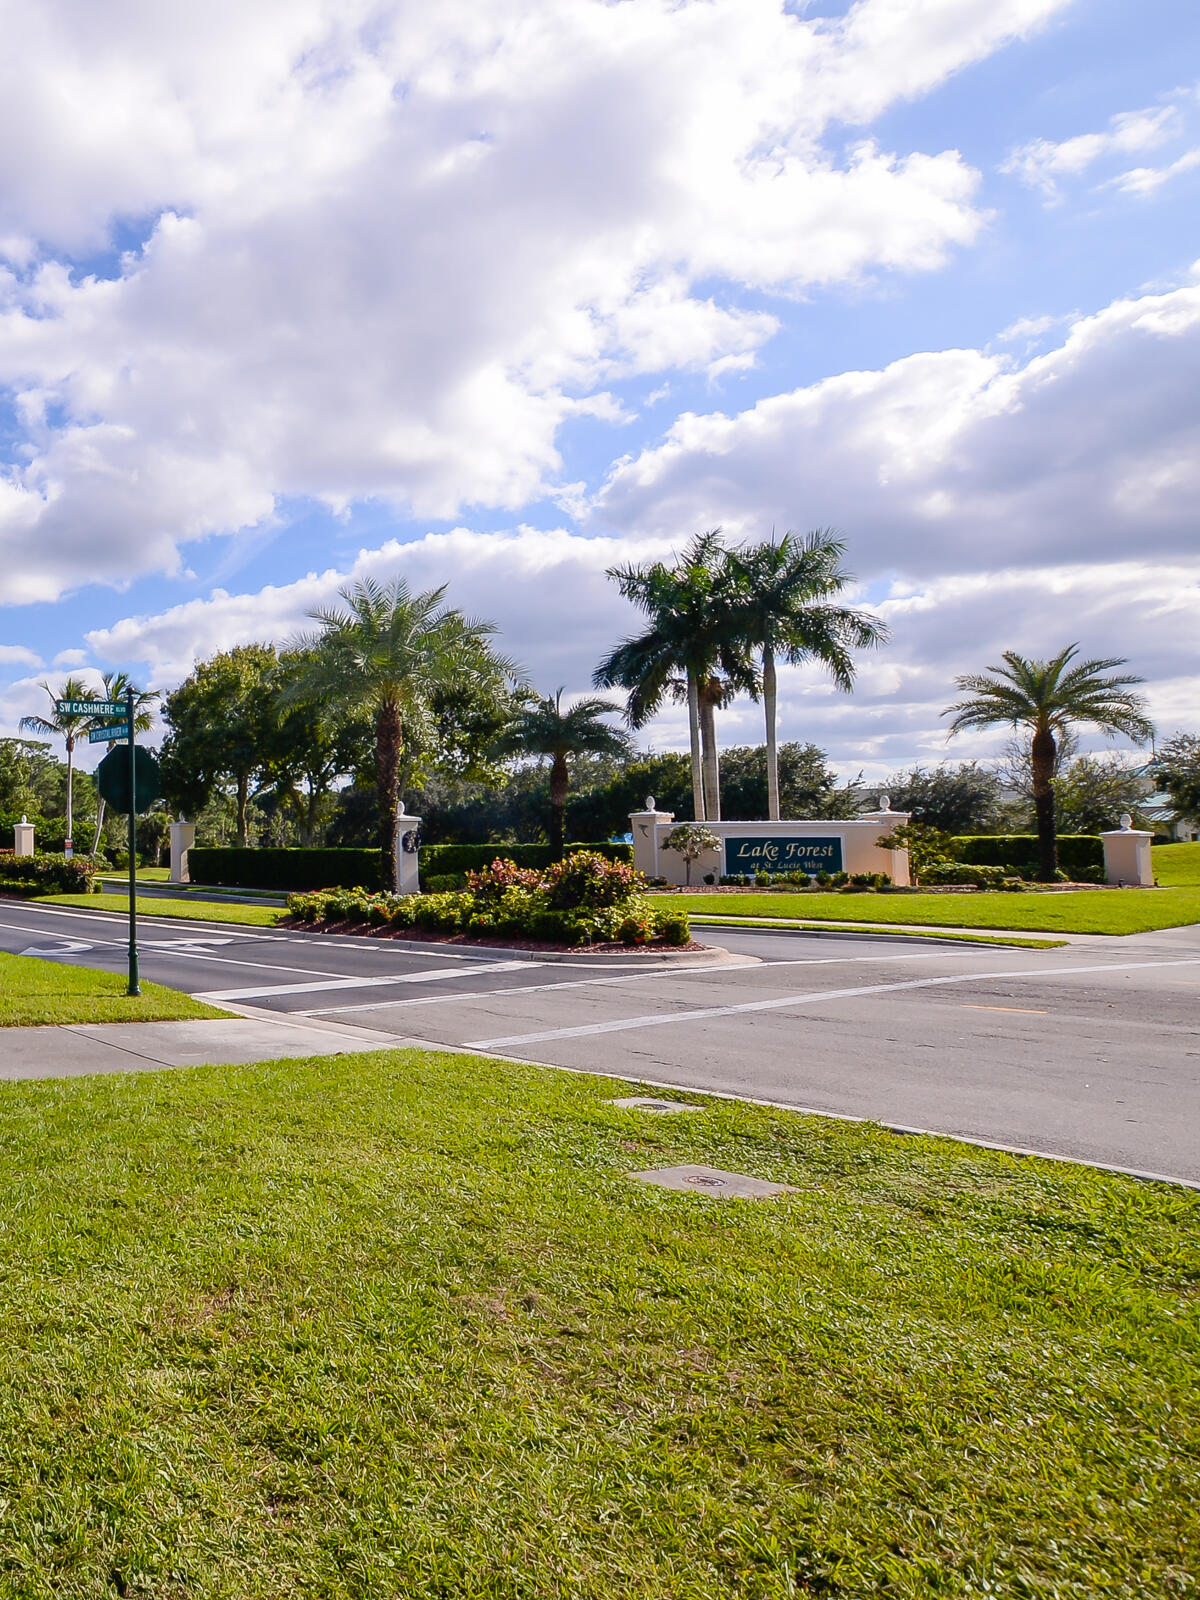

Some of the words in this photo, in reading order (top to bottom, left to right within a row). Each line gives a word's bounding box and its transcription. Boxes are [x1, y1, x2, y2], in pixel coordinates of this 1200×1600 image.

[59, 702, 71, 713] SW
[72, 702, 115, 714] CASHMERE
[96, 729, 111, 740] CRYSTAL
[111, 727, 122, 737] RIVER
[736, 840, 779, 861] Lake
[785, 842, 834, 860] Forest
[763, 861, 774, 869] St.
[777, 861, 801, 869] Lucie
[804, 860, 824, 869] West
